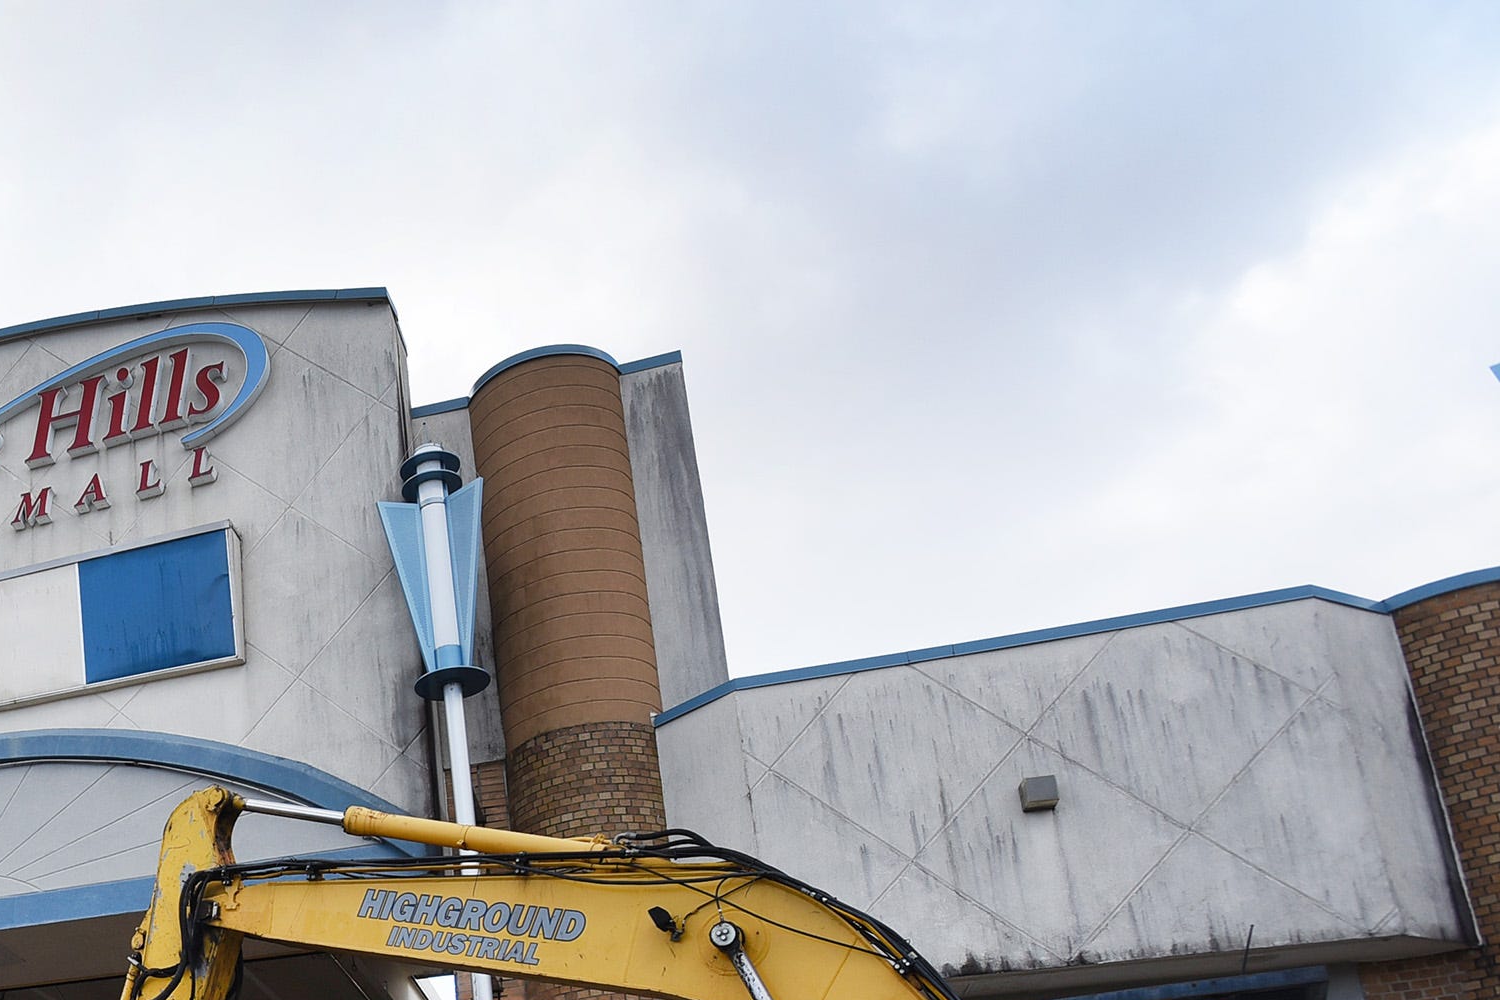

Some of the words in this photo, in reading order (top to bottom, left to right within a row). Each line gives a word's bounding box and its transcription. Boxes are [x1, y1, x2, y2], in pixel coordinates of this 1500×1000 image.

[25, 346, 229, 468] Hills
[11, 445, 218, 532] MALL
[358, 889, 586, 942] HIGHGROUND
[386, 926, 540, 965] INDUSTRIAL
